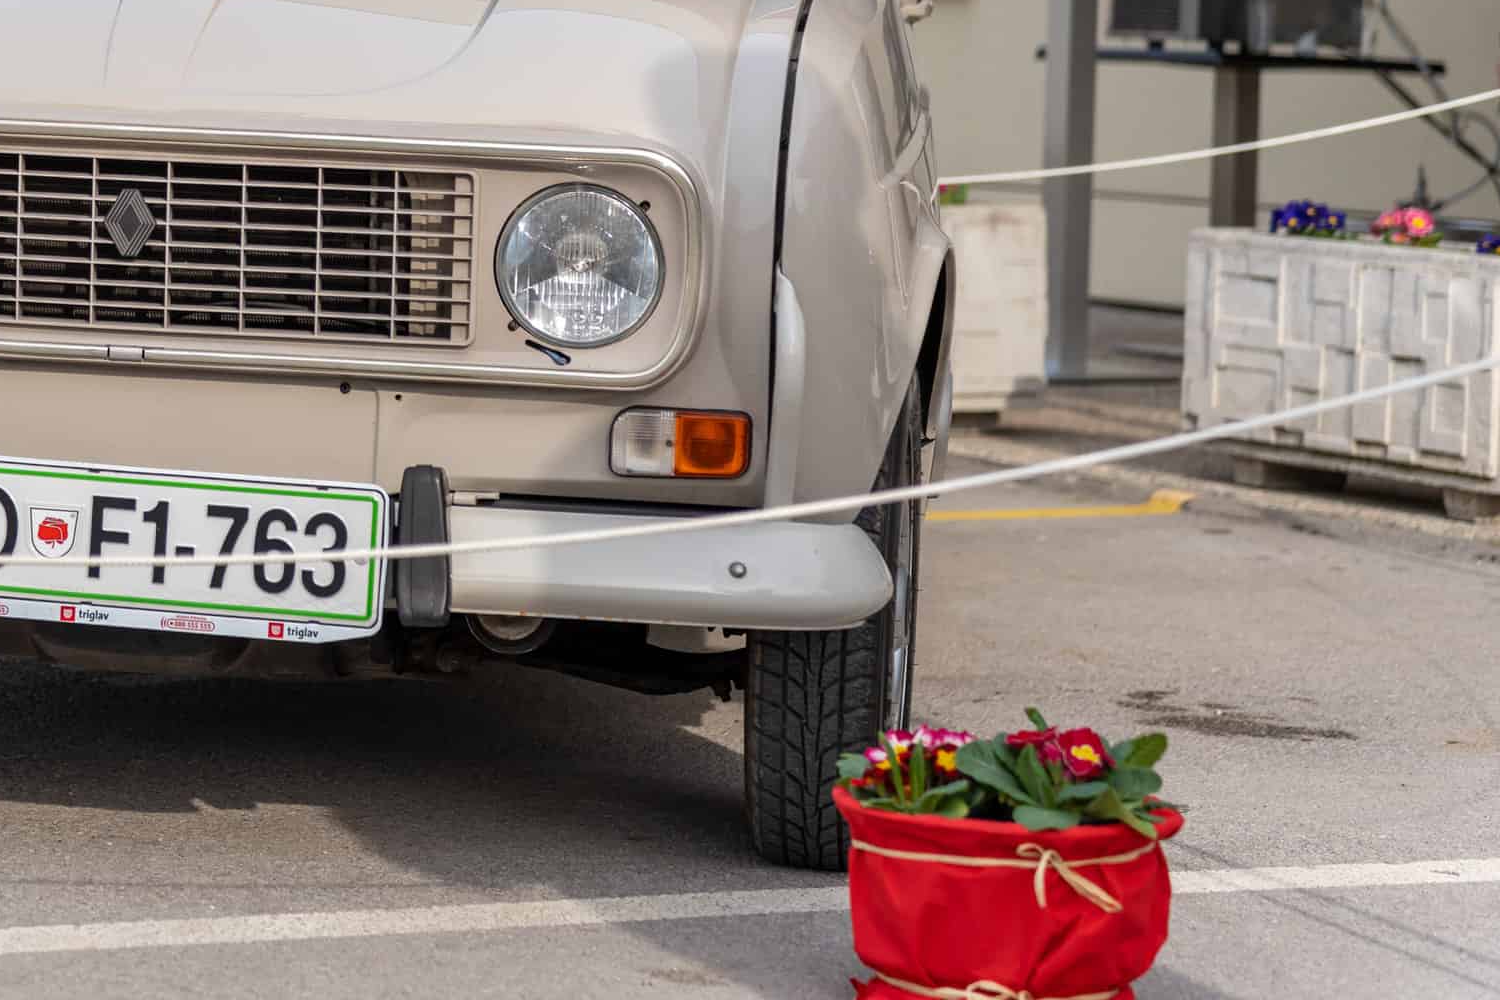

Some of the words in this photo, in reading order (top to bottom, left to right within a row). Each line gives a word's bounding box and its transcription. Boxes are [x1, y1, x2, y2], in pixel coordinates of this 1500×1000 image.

[88, 494, 348, 598] F1-763
[78, 609, 109, 622] triglav
[287, 626, 319, 639] triglav
